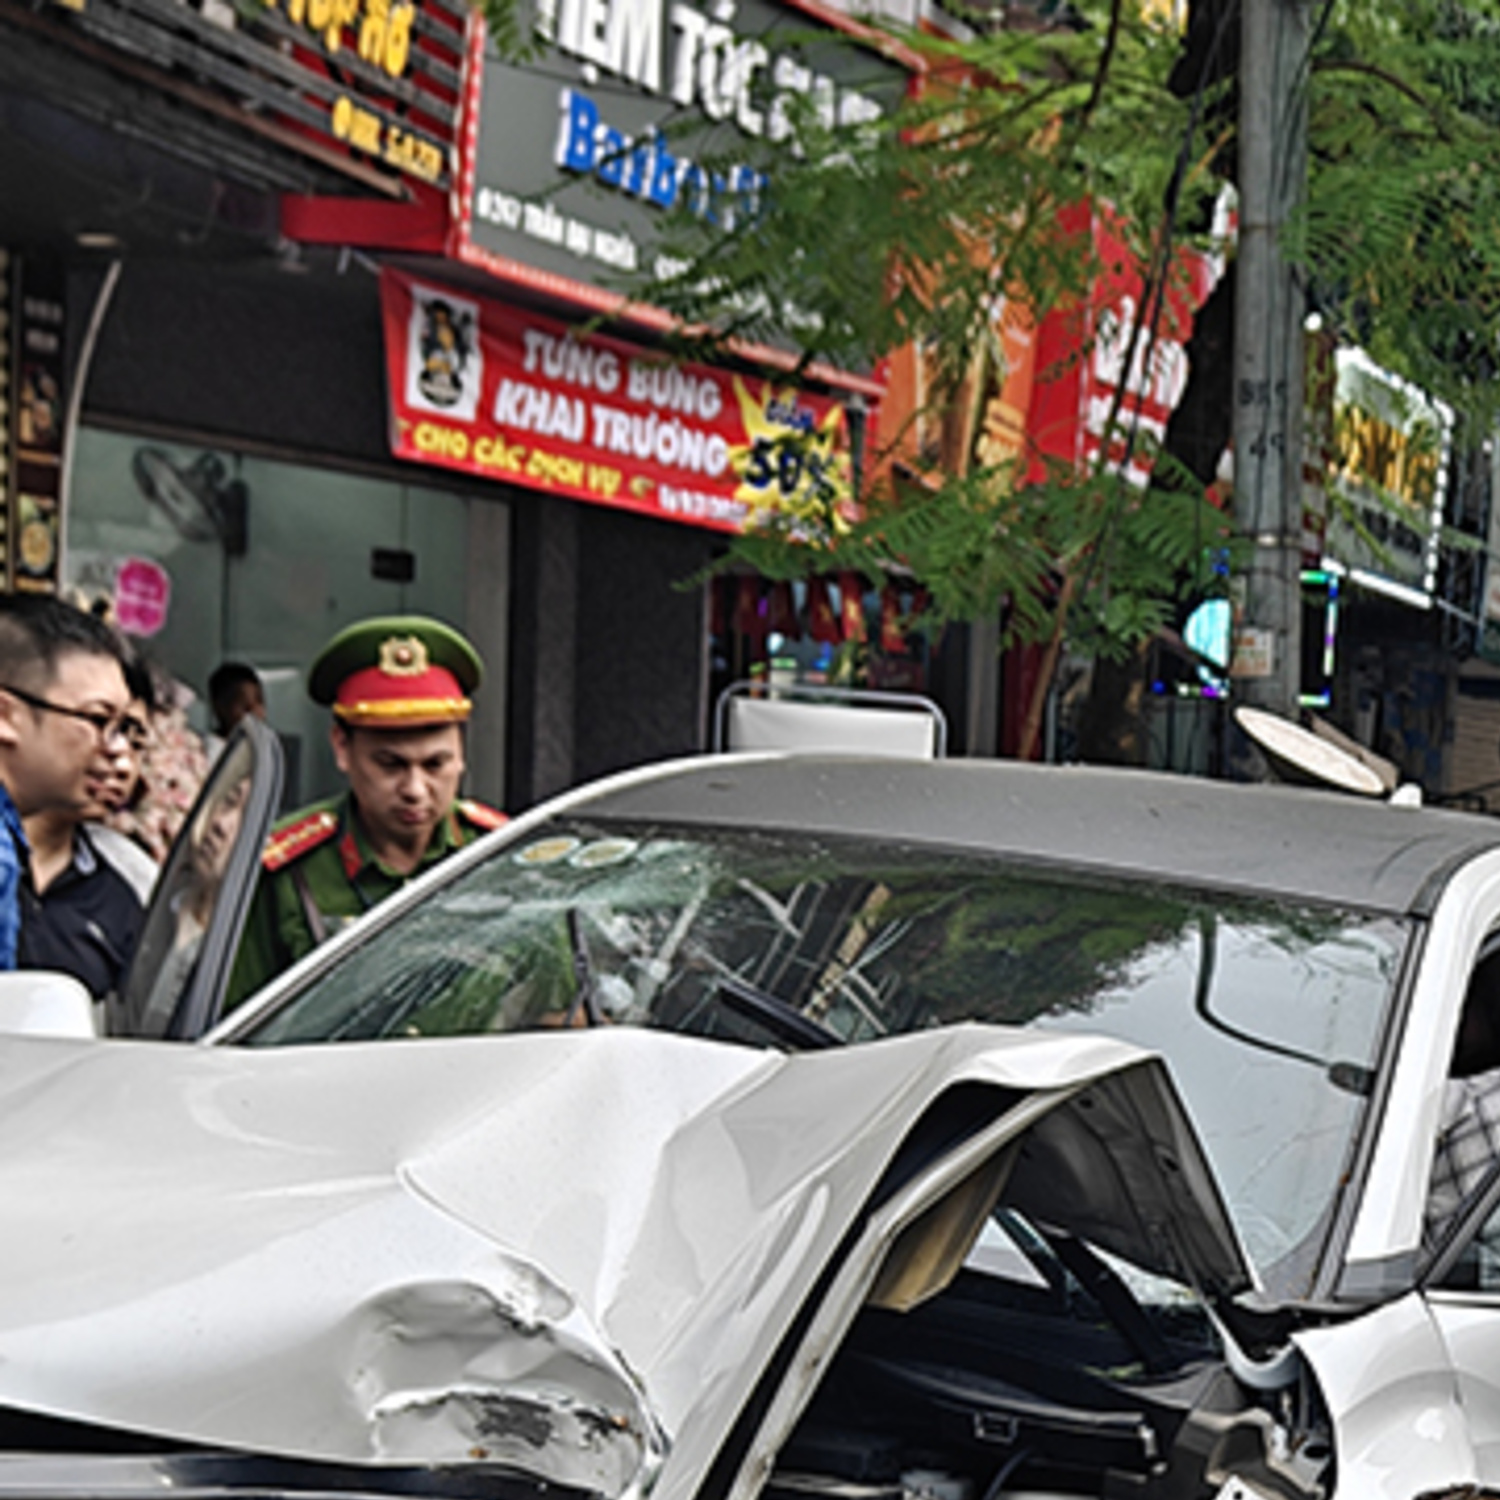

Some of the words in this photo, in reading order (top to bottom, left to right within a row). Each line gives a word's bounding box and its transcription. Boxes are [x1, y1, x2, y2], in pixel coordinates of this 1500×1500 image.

[413, 421, 470, 460] CHO
[473, 433, 526, 473] CÁC
[526, 449, 585, 488] DỊCH
[587, 463, 623, 499] VỤ
[494, 377, 585, 442] KHAI
[591, 403, 728, 477] TRƯƠNG
